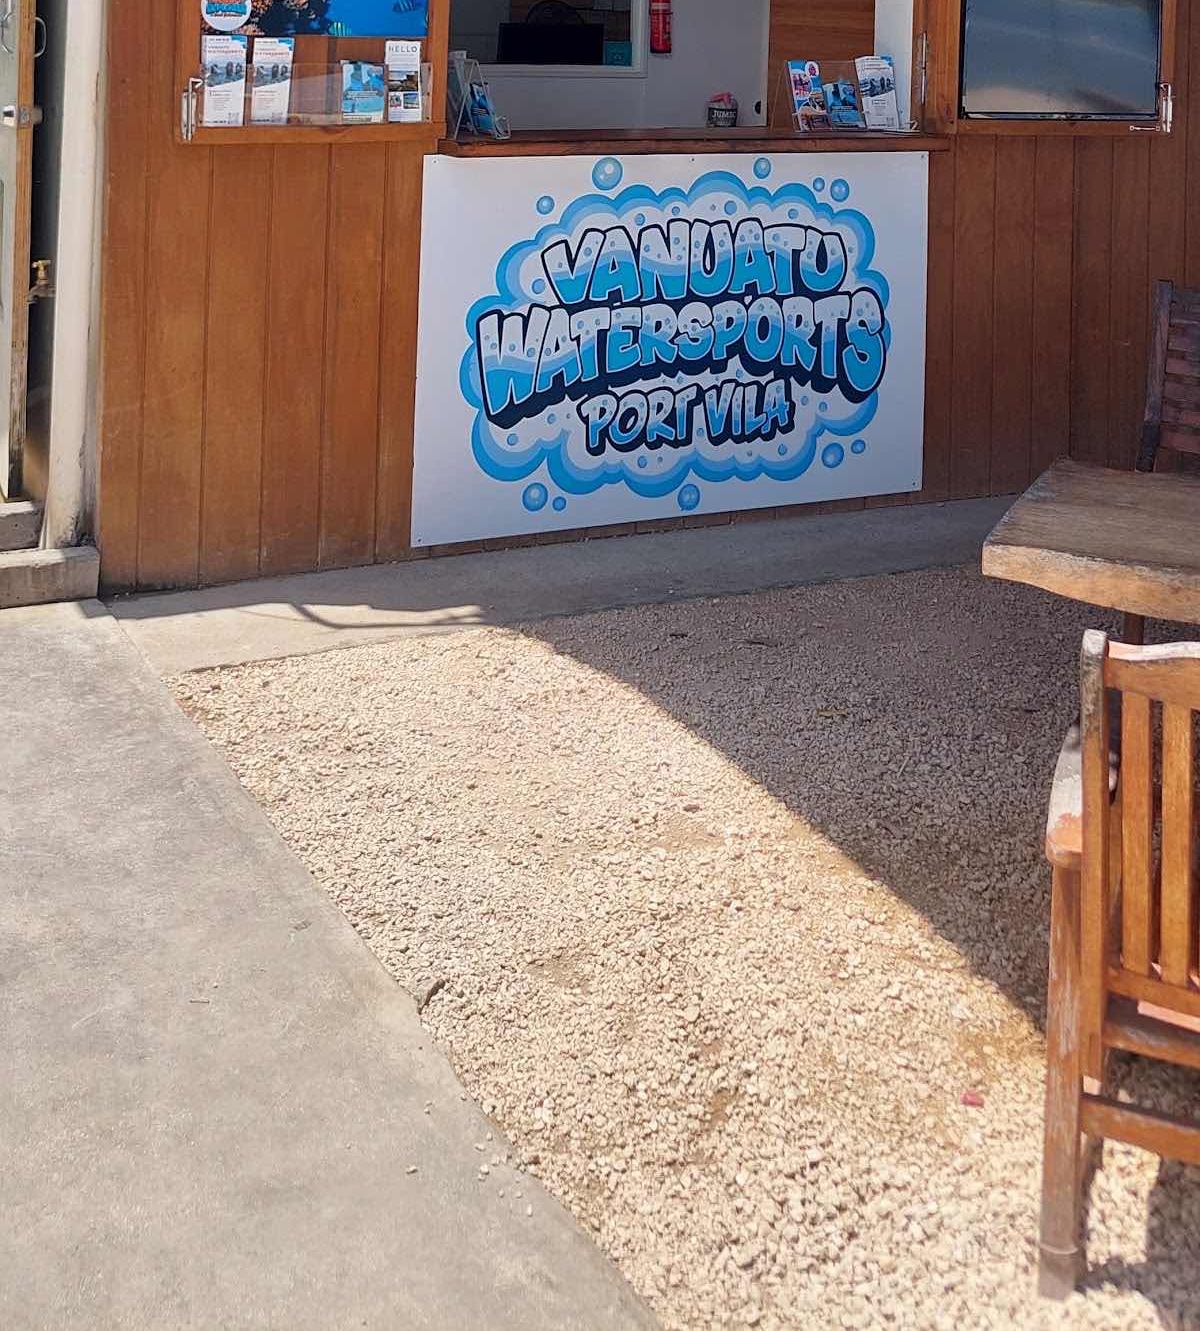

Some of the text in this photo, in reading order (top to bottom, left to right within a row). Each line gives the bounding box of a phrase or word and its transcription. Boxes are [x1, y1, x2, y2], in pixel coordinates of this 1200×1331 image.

[388, 45, 418, 53] HELLO
[541, 218, 848, 305] VANUATU
[477, 287, 887, 424] WATERSPORTS
[577, 377, 795, 451] PORT VILA
